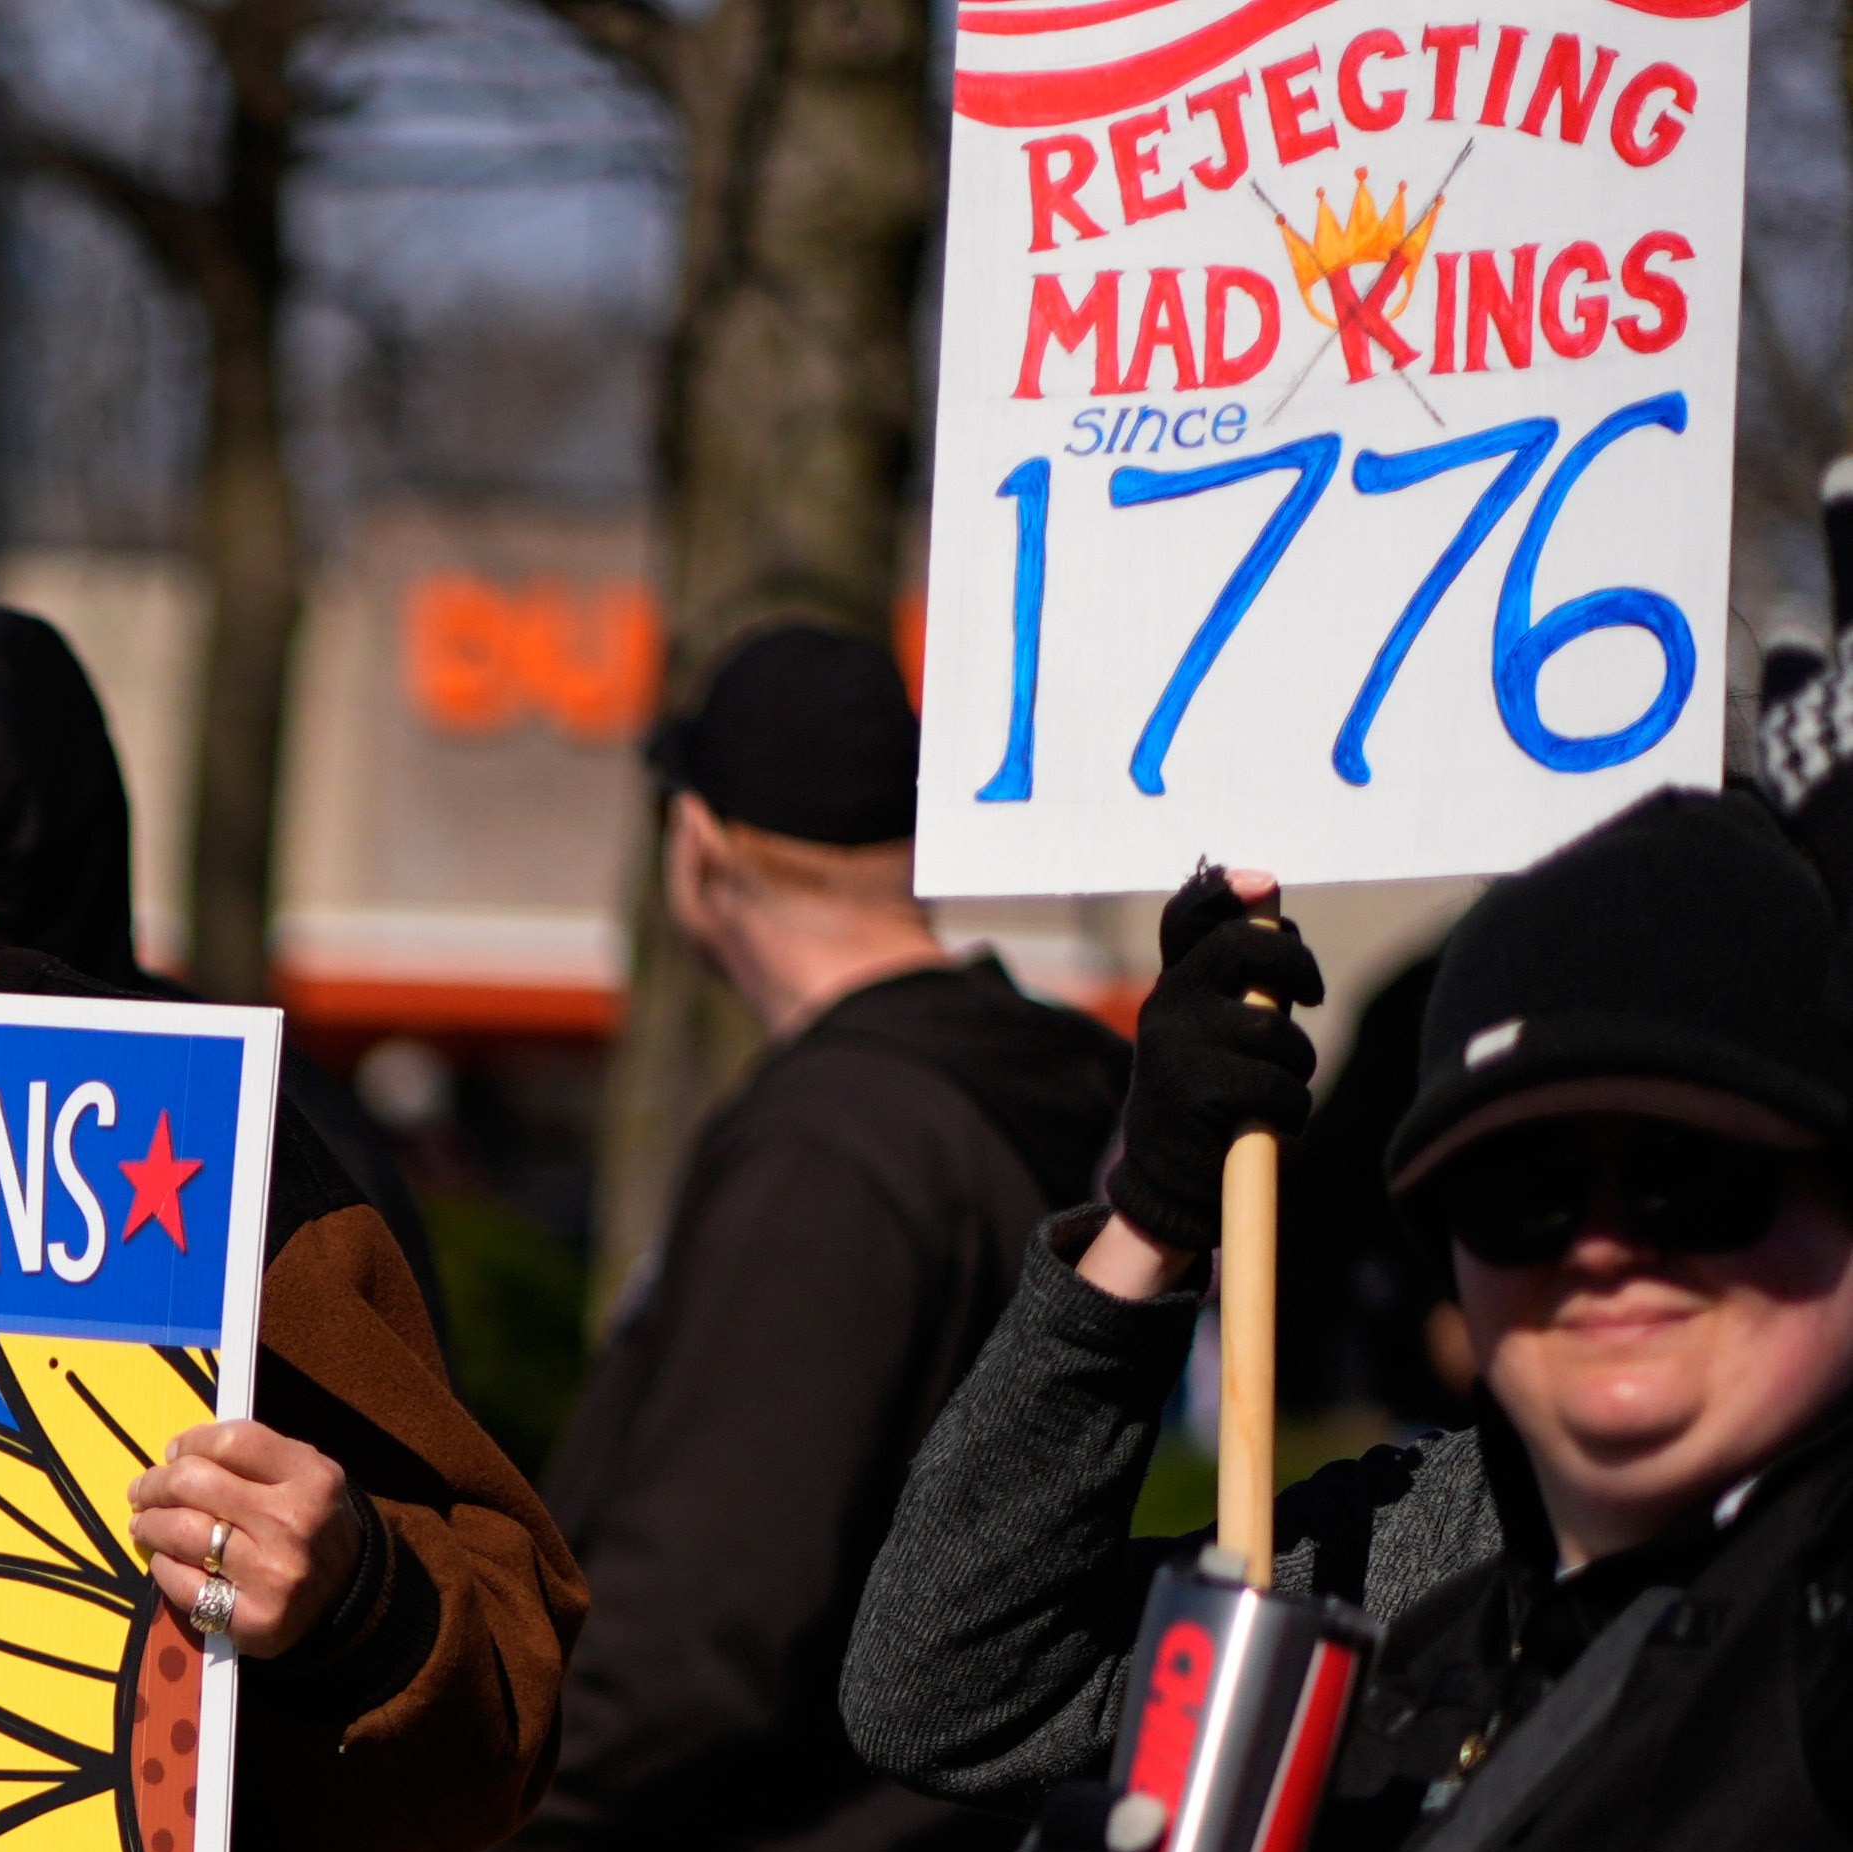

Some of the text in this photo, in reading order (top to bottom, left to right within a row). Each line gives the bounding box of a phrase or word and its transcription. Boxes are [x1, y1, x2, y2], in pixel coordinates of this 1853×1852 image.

[1021, 22, 1698, 253] REJECTING
[1011, 230, 1697, 399] MAD KINGS
[1064, 399, 1248, 457] since
[973, 390, 1698, 803] 1776
